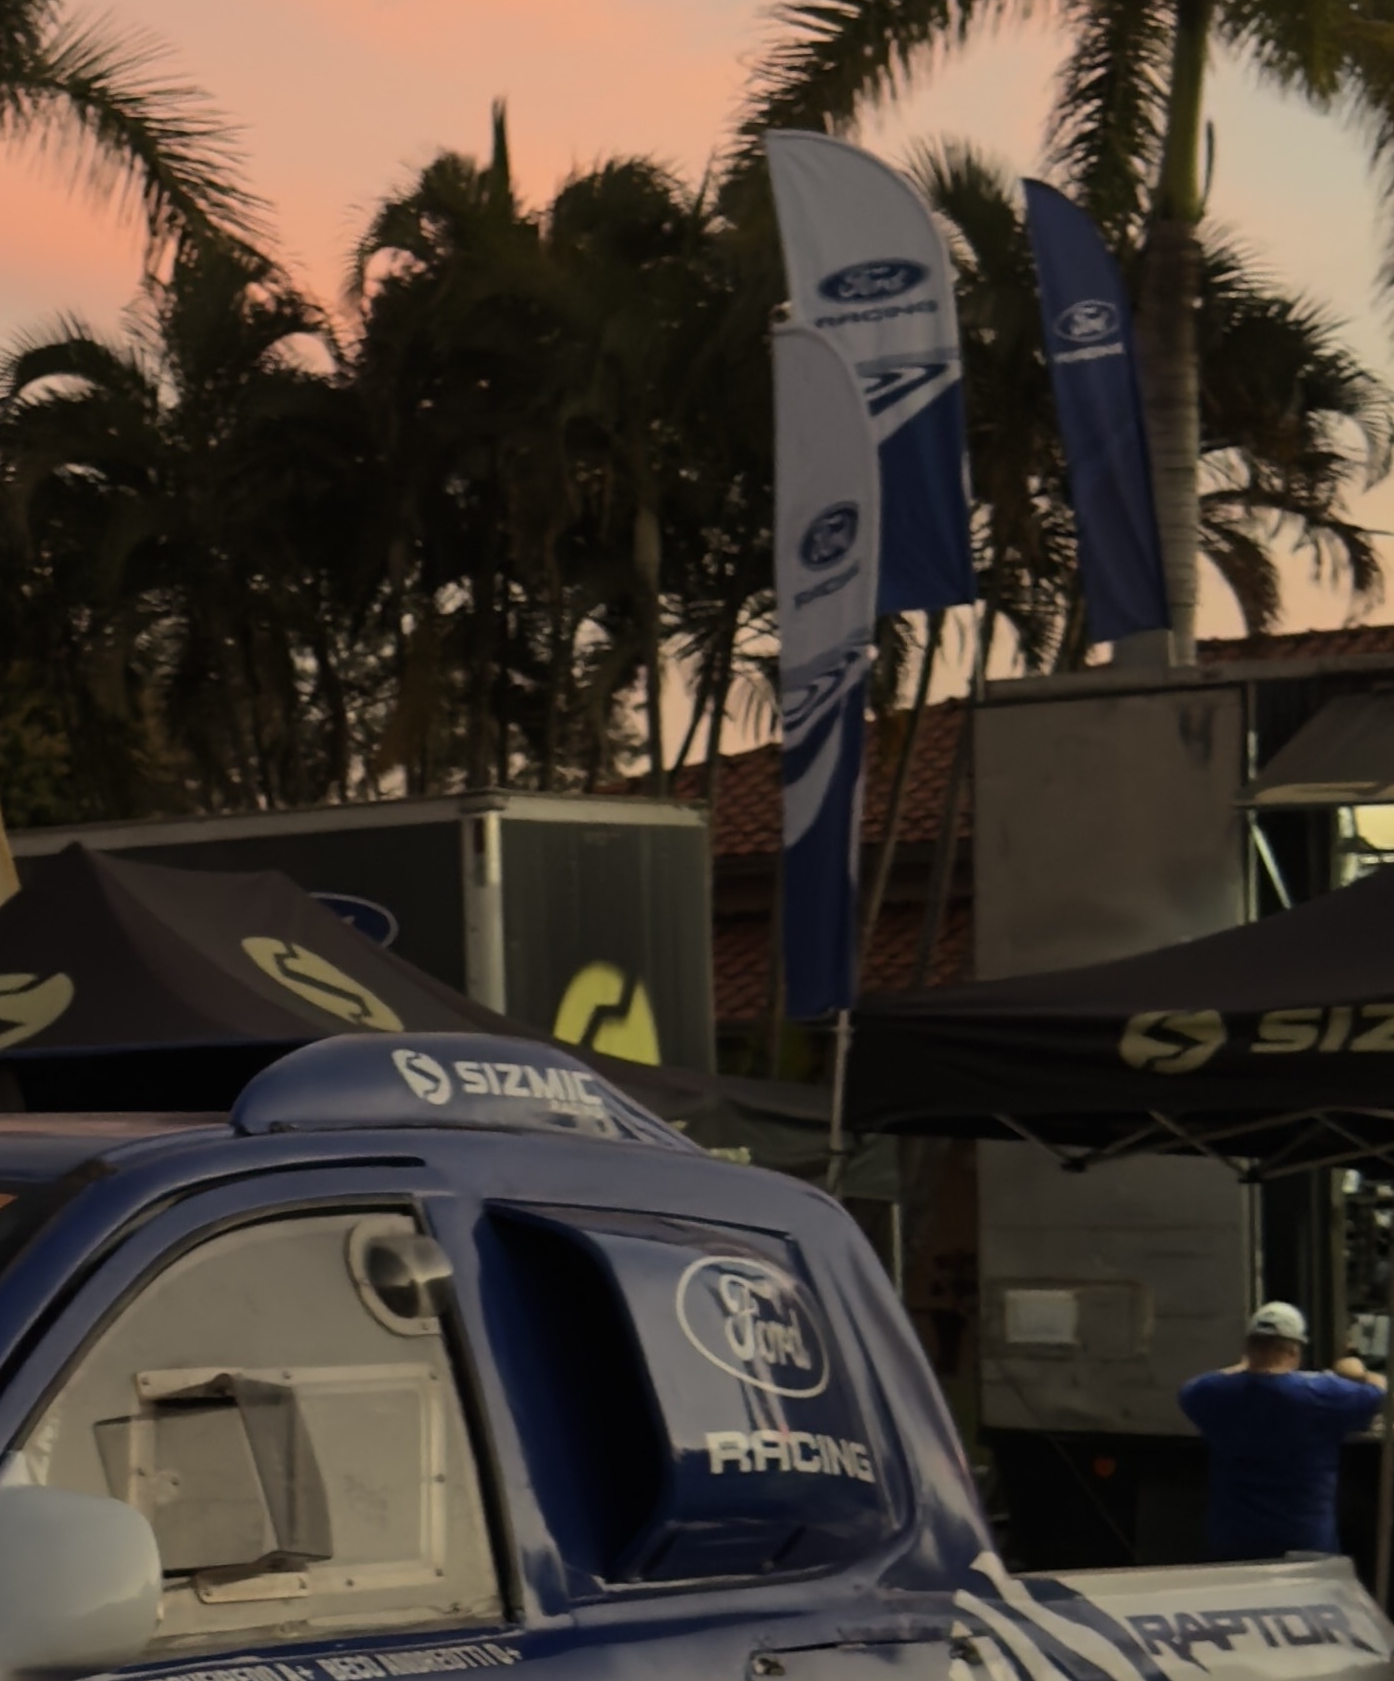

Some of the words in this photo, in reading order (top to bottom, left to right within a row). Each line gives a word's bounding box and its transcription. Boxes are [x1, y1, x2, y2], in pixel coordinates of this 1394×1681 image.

[452, 1060, 604, 1106] SIZMIC
[718, 1273, 812, 1370] Ford
[705, 1428, 877, 1485] RACING
[1123, 1603, 1383, 1674] RAPTOR
